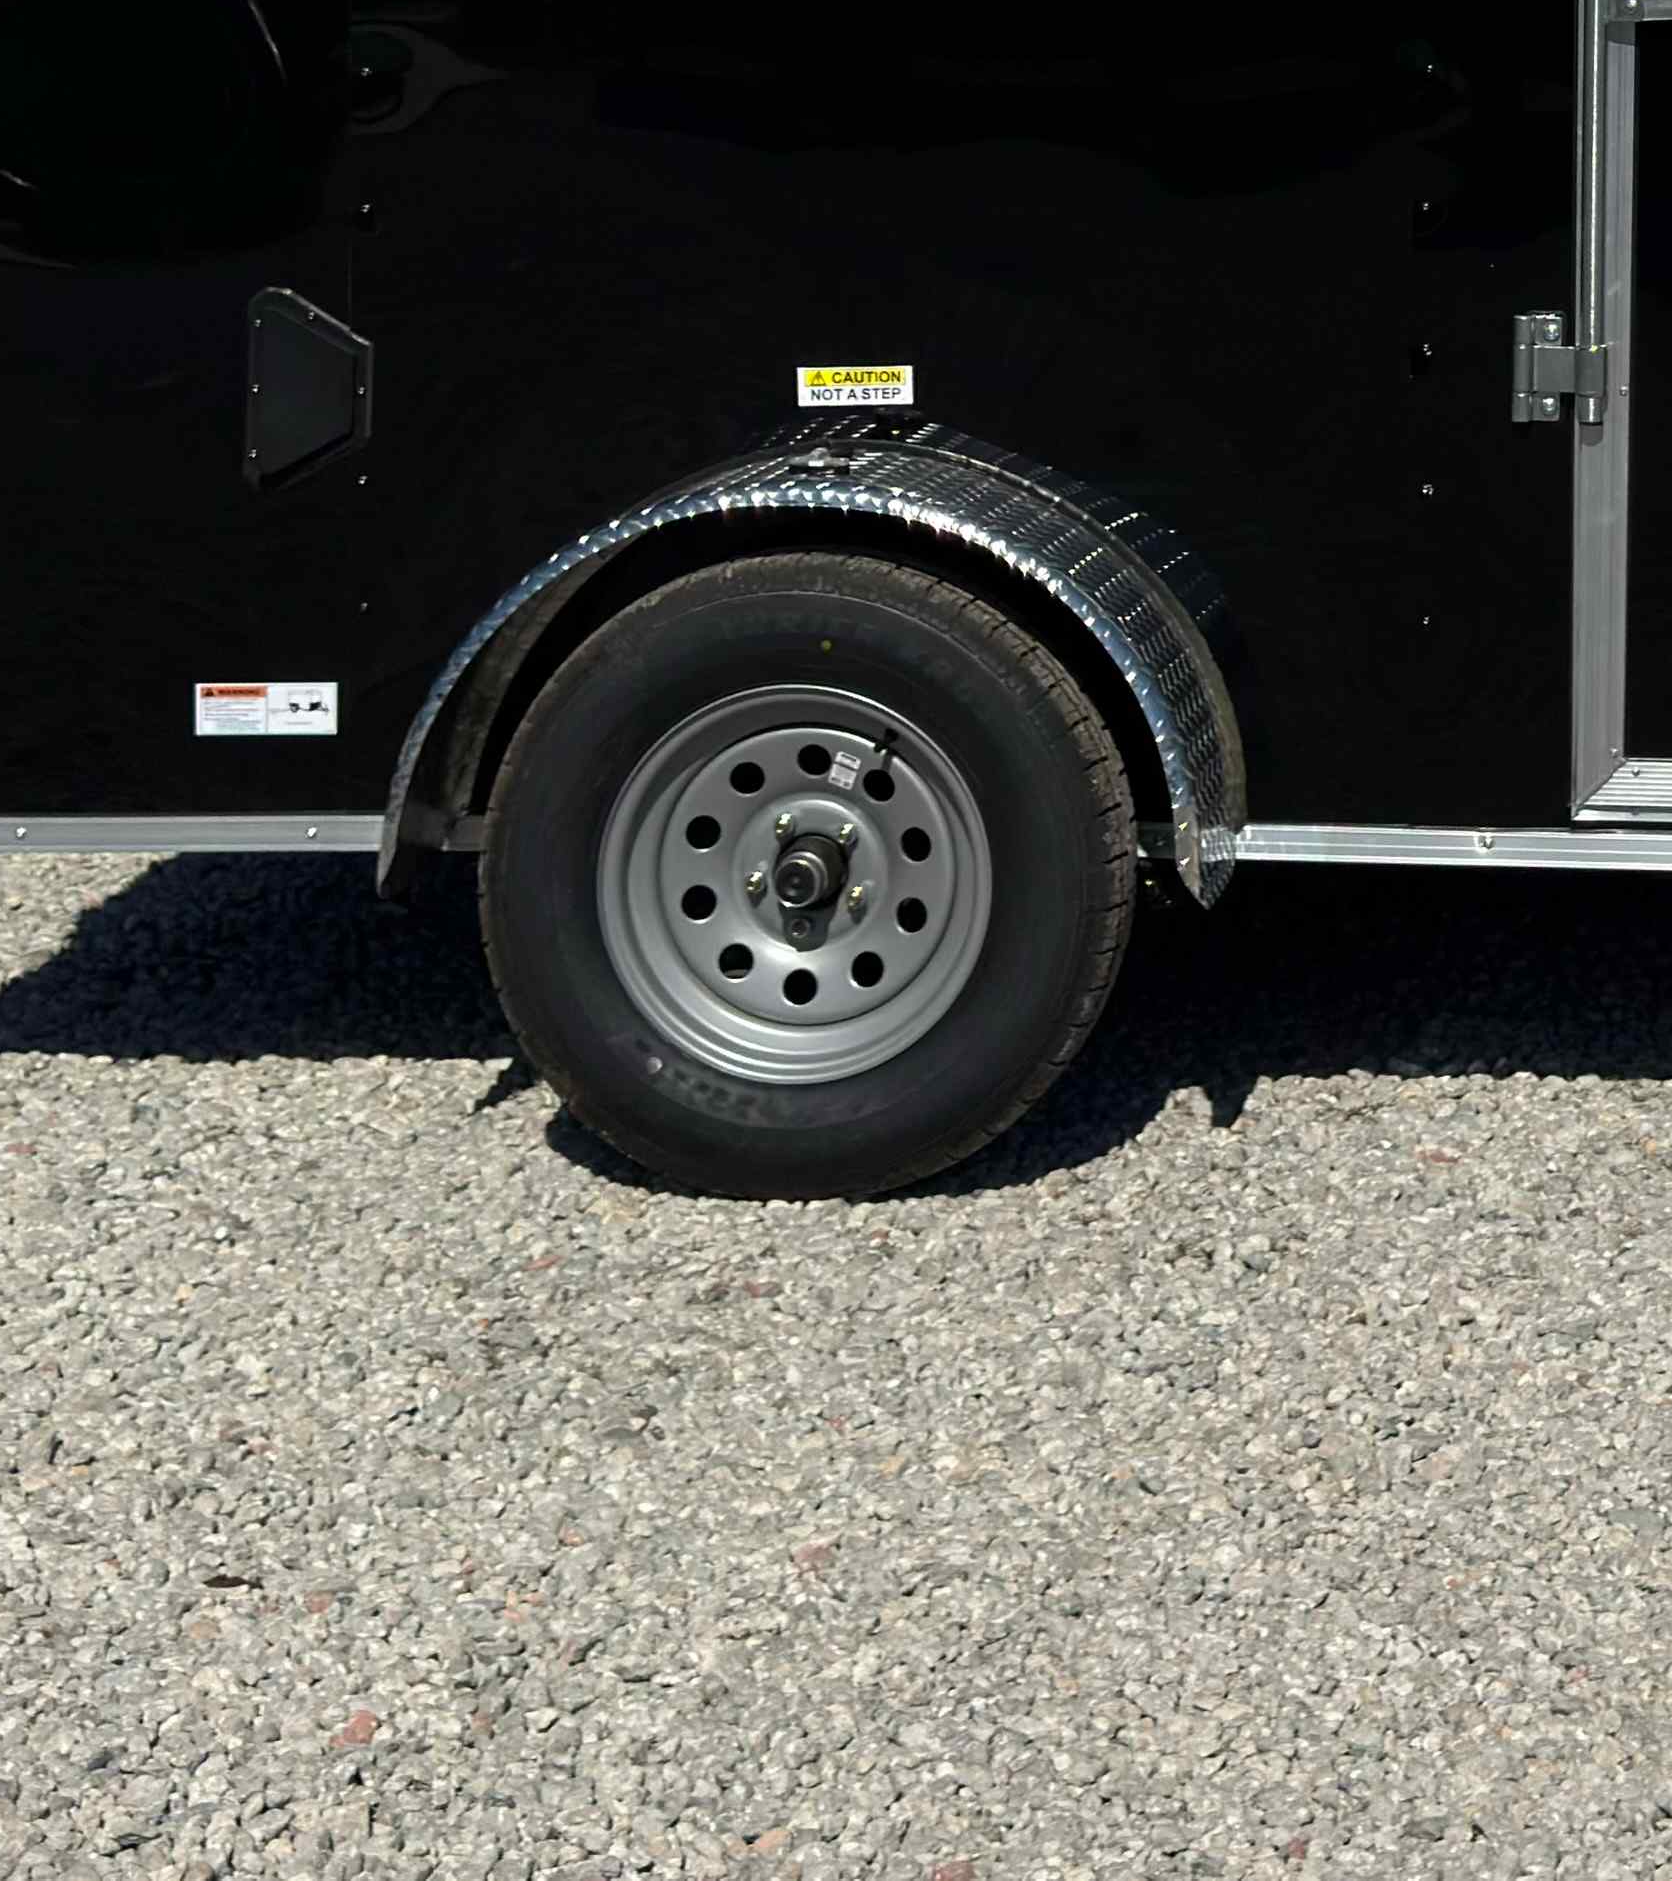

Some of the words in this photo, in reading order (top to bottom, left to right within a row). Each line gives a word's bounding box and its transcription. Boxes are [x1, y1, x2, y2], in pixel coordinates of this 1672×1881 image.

[831, 370, 902, 384] CAUTION
[810, 388, 843, 401] NOT
[847, 388, 858, 400] A
[861, 387, 902, 400] STEP
